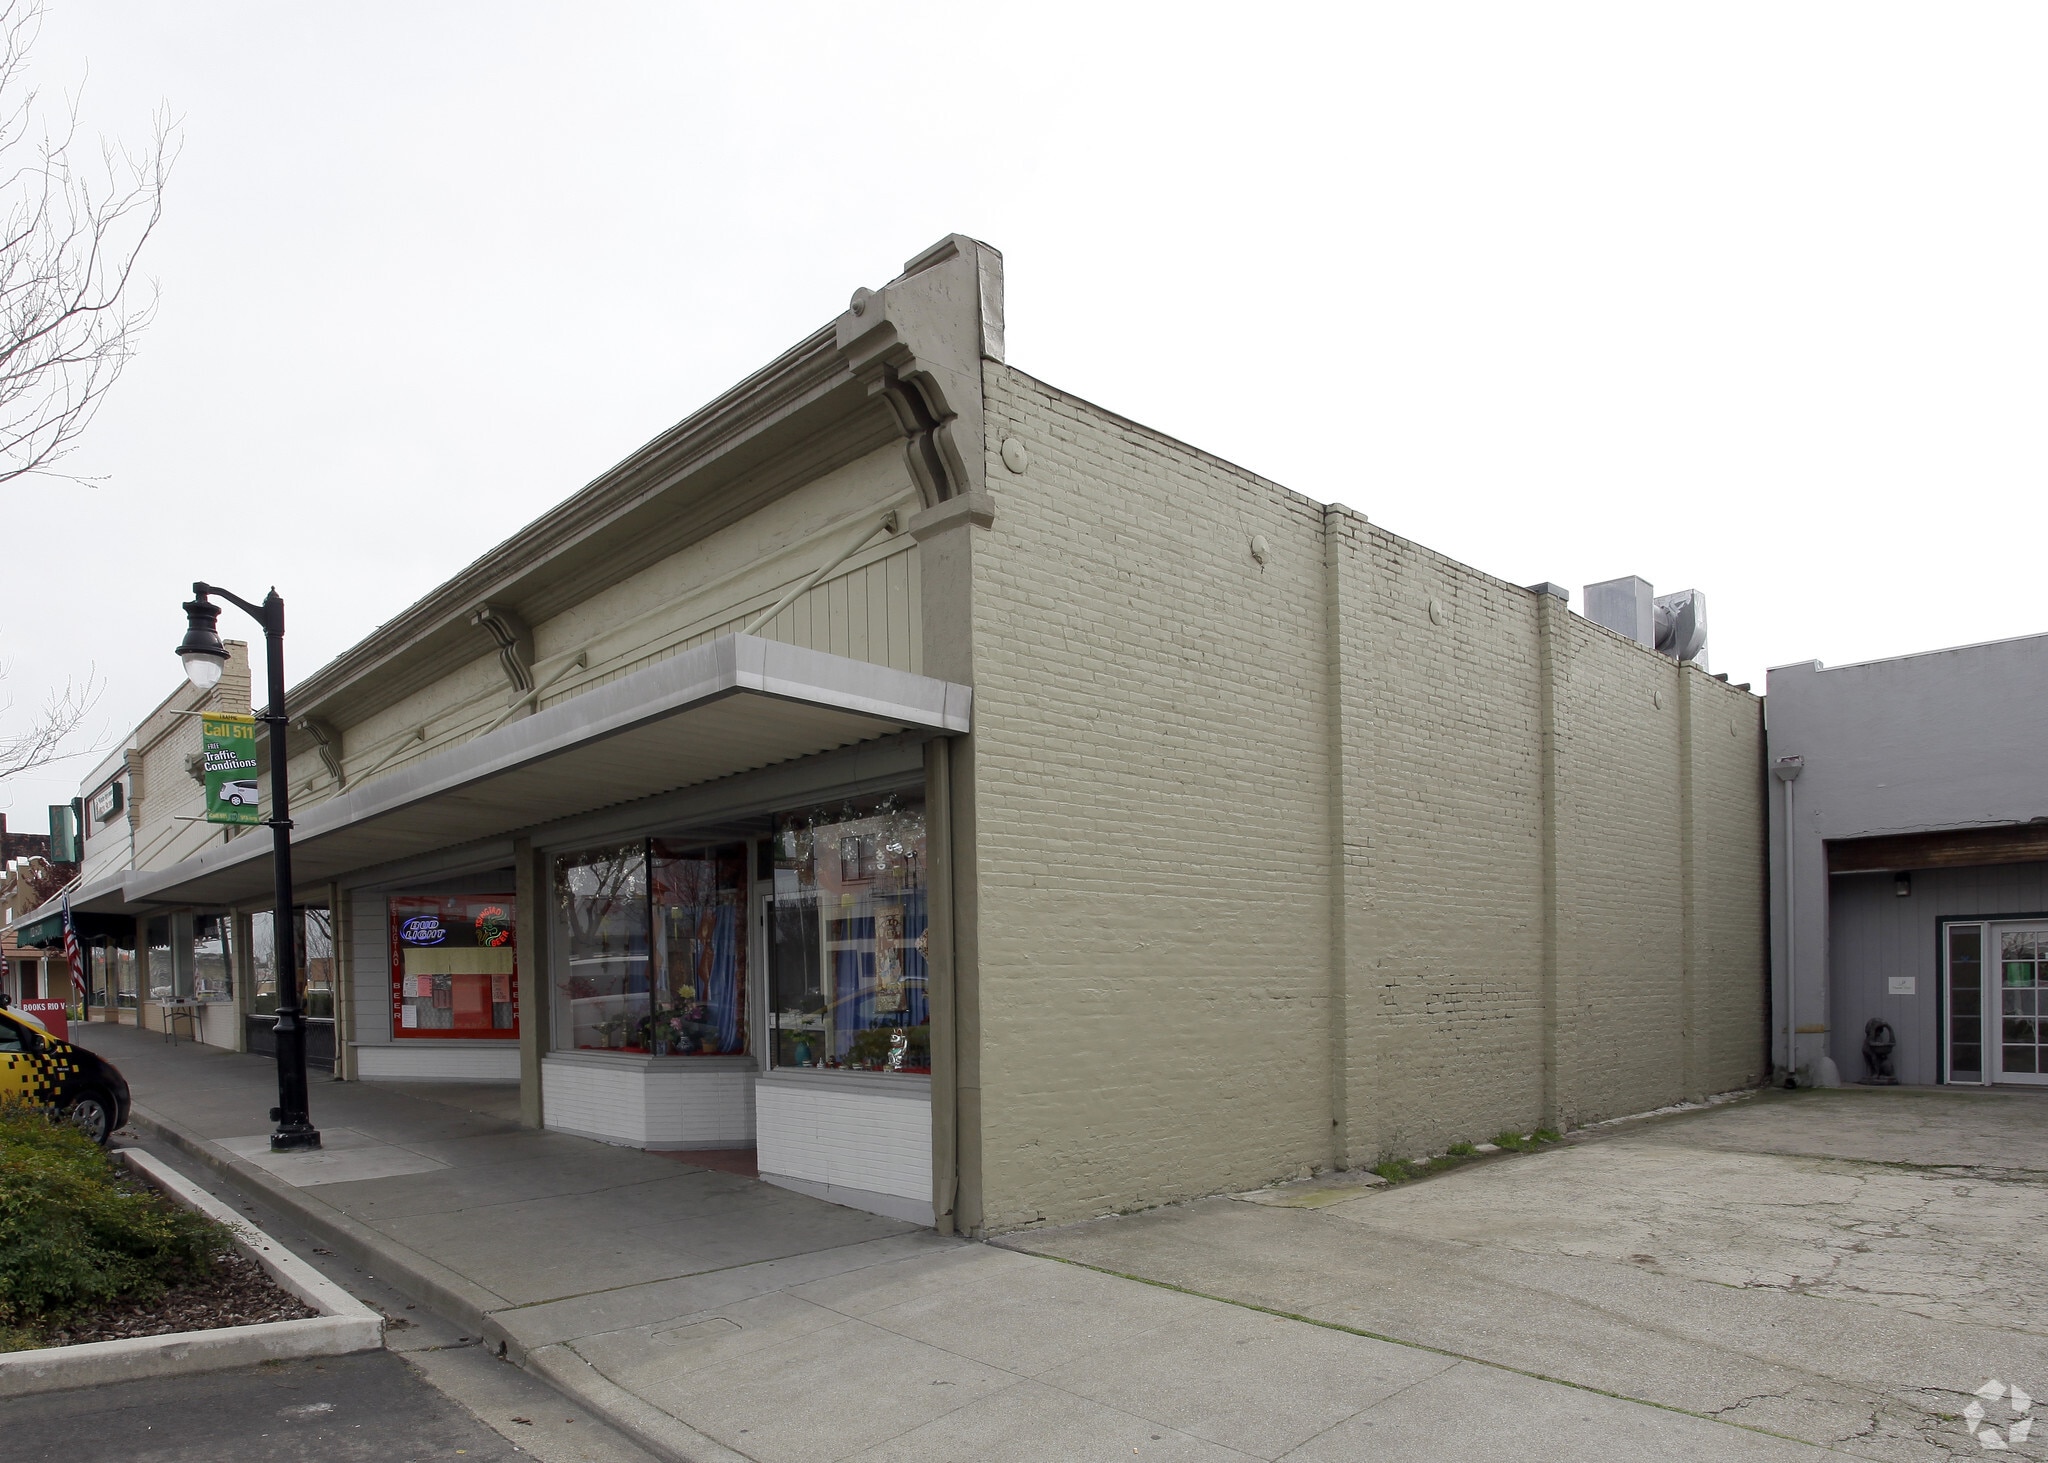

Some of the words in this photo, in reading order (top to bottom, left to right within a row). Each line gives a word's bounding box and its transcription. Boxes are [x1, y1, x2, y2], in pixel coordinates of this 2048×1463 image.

[203, 722, 230, 737] Call
[233, 725, 253, 739] 511
[204, 750, 236, 762] Traffic
[204, 759, 257, 771] Conditions
[475, 906, 503, 928] TSINGTAO
[409, 920, 439, 930] BUD
[405, 929, 446, 940] LIGHT
[491, 930, 509, 947] BEER
[23, 1003, 46, 1012] BOOKS
[47, 1002, 59, 1011] RIO
[393, 983, 402, 1019] BEER
